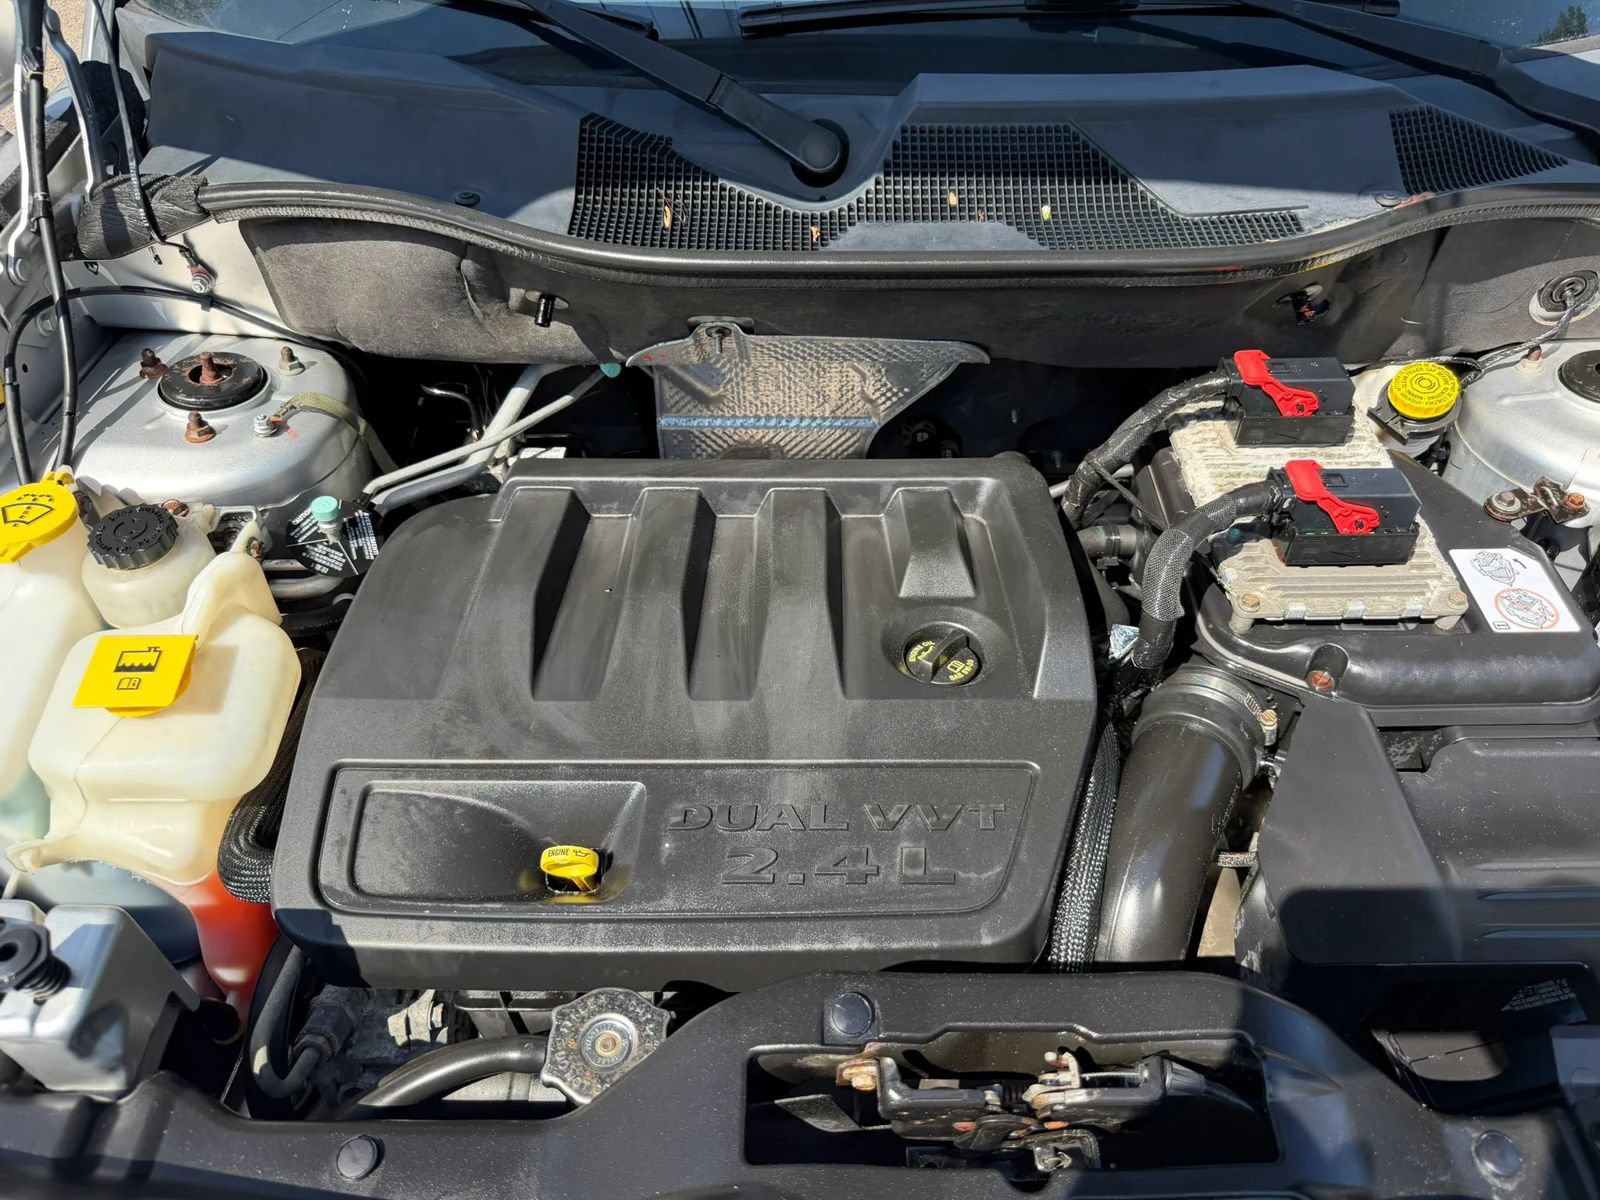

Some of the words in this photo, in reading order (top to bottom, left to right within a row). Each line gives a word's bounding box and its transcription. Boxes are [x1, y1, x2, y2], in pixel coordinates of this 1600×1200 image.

[667, 803, 849, 831] DUAL
[864, 803, 1006, 831] VVT
[547, 848, 570, 858] ENGINE
[720, 847, 956, 886] 2.4L
